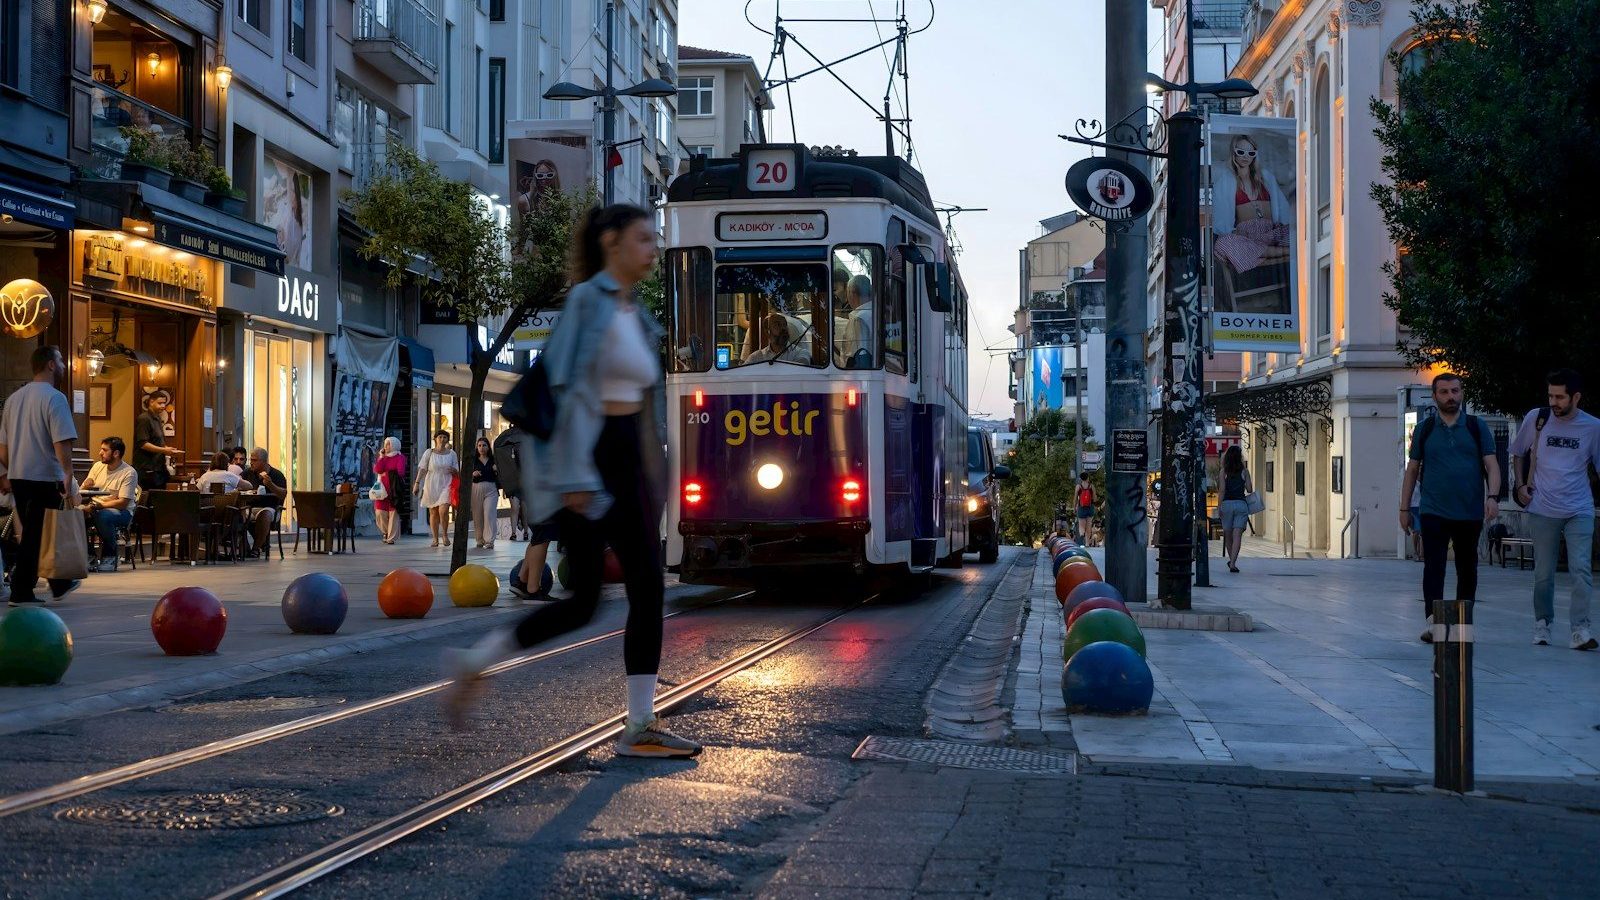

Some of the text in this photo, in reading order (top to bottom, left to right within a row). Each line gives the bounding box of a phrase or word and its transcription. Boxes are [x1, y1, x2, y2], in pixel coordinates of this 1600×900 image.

[756, 162, 788, 184] 20
[729, 222, 774, 232] KADIKÖY
[784, 222, 815, 231] MODA
[1220, 317, 1293, 329] BOYNER
[687, 412, 710, 424] 210
[724, 400, 820, 446] getir
